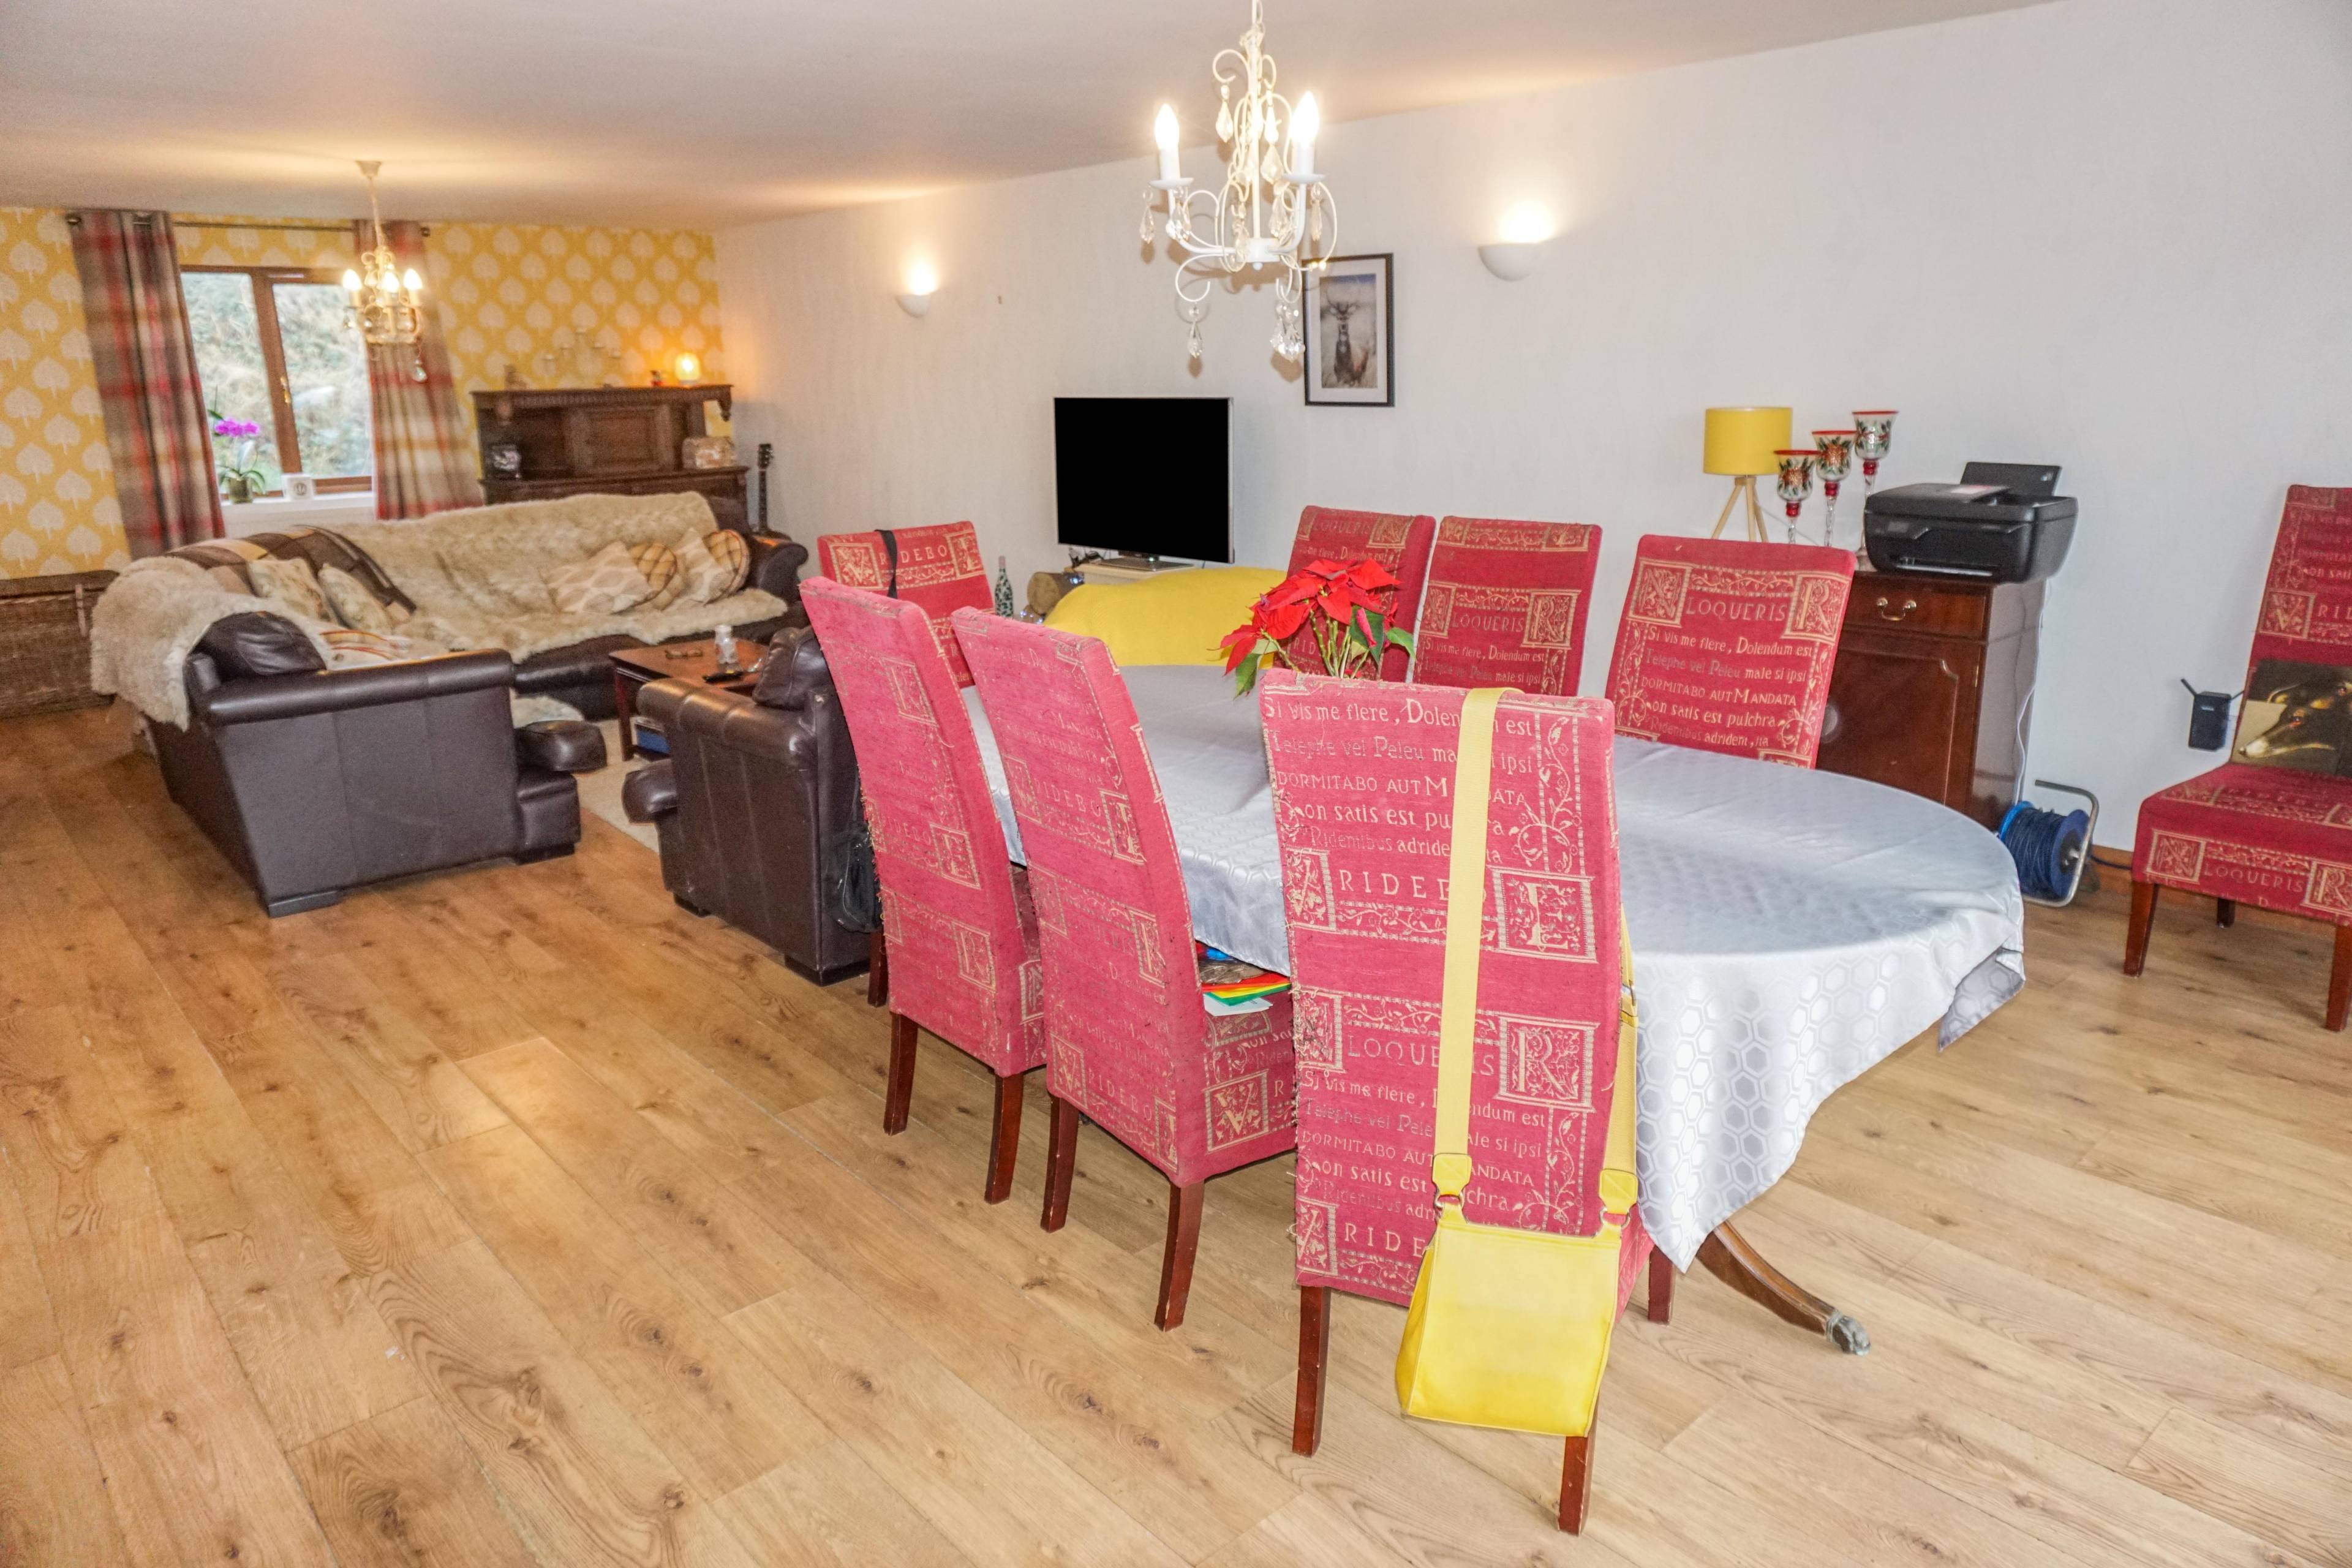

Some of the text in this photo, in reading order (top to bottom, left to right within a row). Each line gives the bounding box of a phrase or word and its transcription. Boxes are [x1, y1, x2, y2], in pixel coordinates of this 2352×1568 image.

[880, 545, 948, 565] RDEBO
[1686, 597, 1789, 622] LOQUERIS
[1452, 613, 1525, 633] LOQUERIS
[1294, 638, 1316, 655] RID
[1648, 626, 1659, 641] Si
[1664, 630, 1679, 644] vis
[1681, 635, 1696, 647] me
[1736, 636, 1792, 656] Dolendum
[1796, 645, 1812, 657] est
[1744, 666, 1772, 680] male
[1774, 668, 1784, 680] si
[1786, 669, 1807, 683] ipsi
[1641, 676, 1706, 698] DORMITABO
[1709, 690, 1733, 702] AUT
[1264, 696, 1282, 718] Si
[1317, 705, 1340, 722] me
[1506, 719, 1532, 737] est
[1671, 704, 1699, 721] satis
[1703, 711, 1722, 724] est
[1727, 710, 1777, 728] pulchra
[1373, 735, 1425, 760] Peleu
[1432, 747, 1458, 763] ma
[1501, 752, 1532, 775] ipsi
[1276, 771, 1378, 791] DORMITABO
[1385, 778, 1421, 795] AUT
[1334, 804, 1379, 824] satis
[1386, 809, 1417, 826] est
[1397, 837, 1452, 858] adride
[2203, 862, 2304, 892] LOQUERIS
[1521, 1111, 1545, 1128] est
[1396, 1114, 1433, 1138] Pele
[1495, 1136, 1507, 1152] si
[1513, 1139, 1542, 1159] ipsi
[1302, 1129, 1396, 1159] DORMITABO
[1470, 1164, 1534, 1187] ANDATA
[1351, 1164, 1392, 1186] satis
[1400, 1175, 1428, 1193] est
[1344, 1223, 1426, 1258] RIDE
